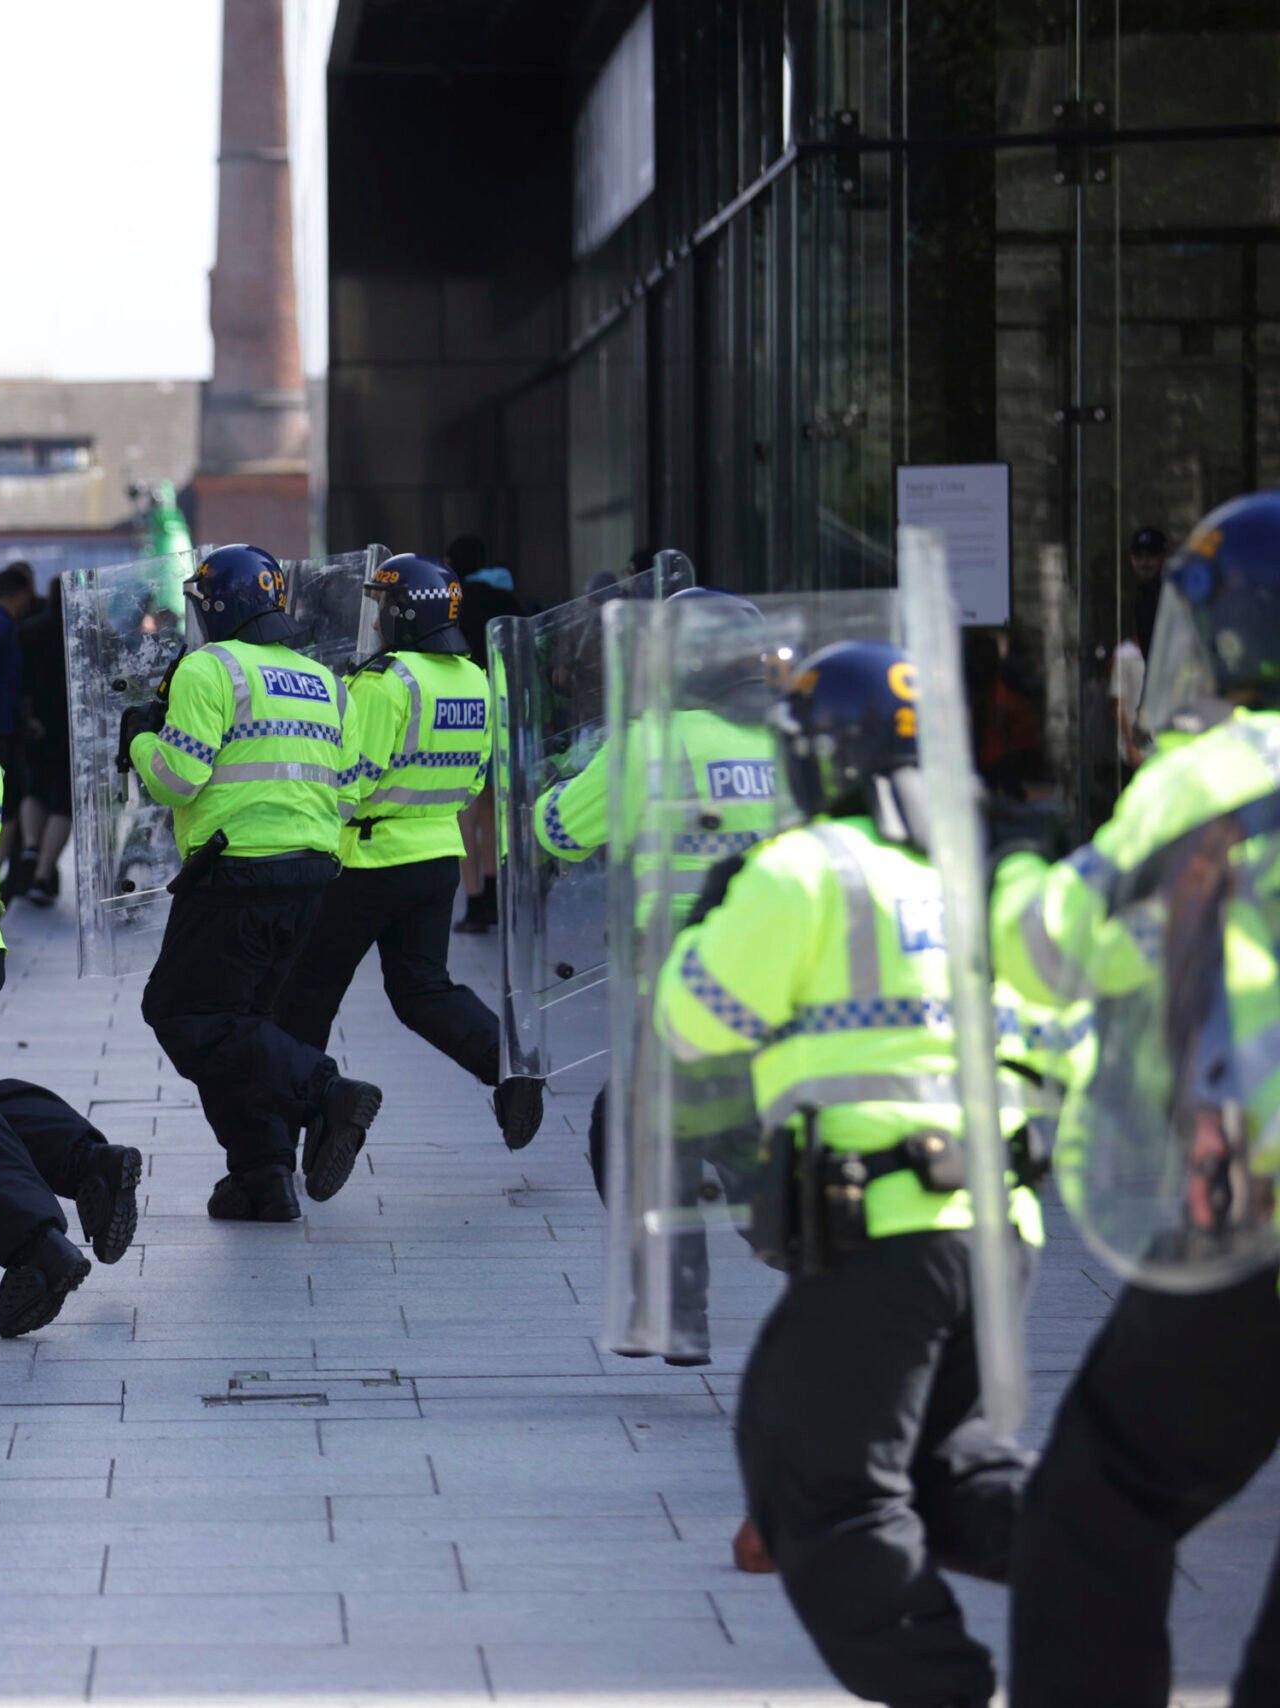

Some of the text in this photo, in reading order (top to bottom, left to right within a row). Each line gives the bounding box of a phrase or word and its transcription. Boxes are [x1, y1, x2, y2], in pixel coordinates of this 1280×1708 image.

[258, 571, 286, 591] CH
[263, 669, 327, 697] POLICE
[437, 702, 484, 725] POLICE
